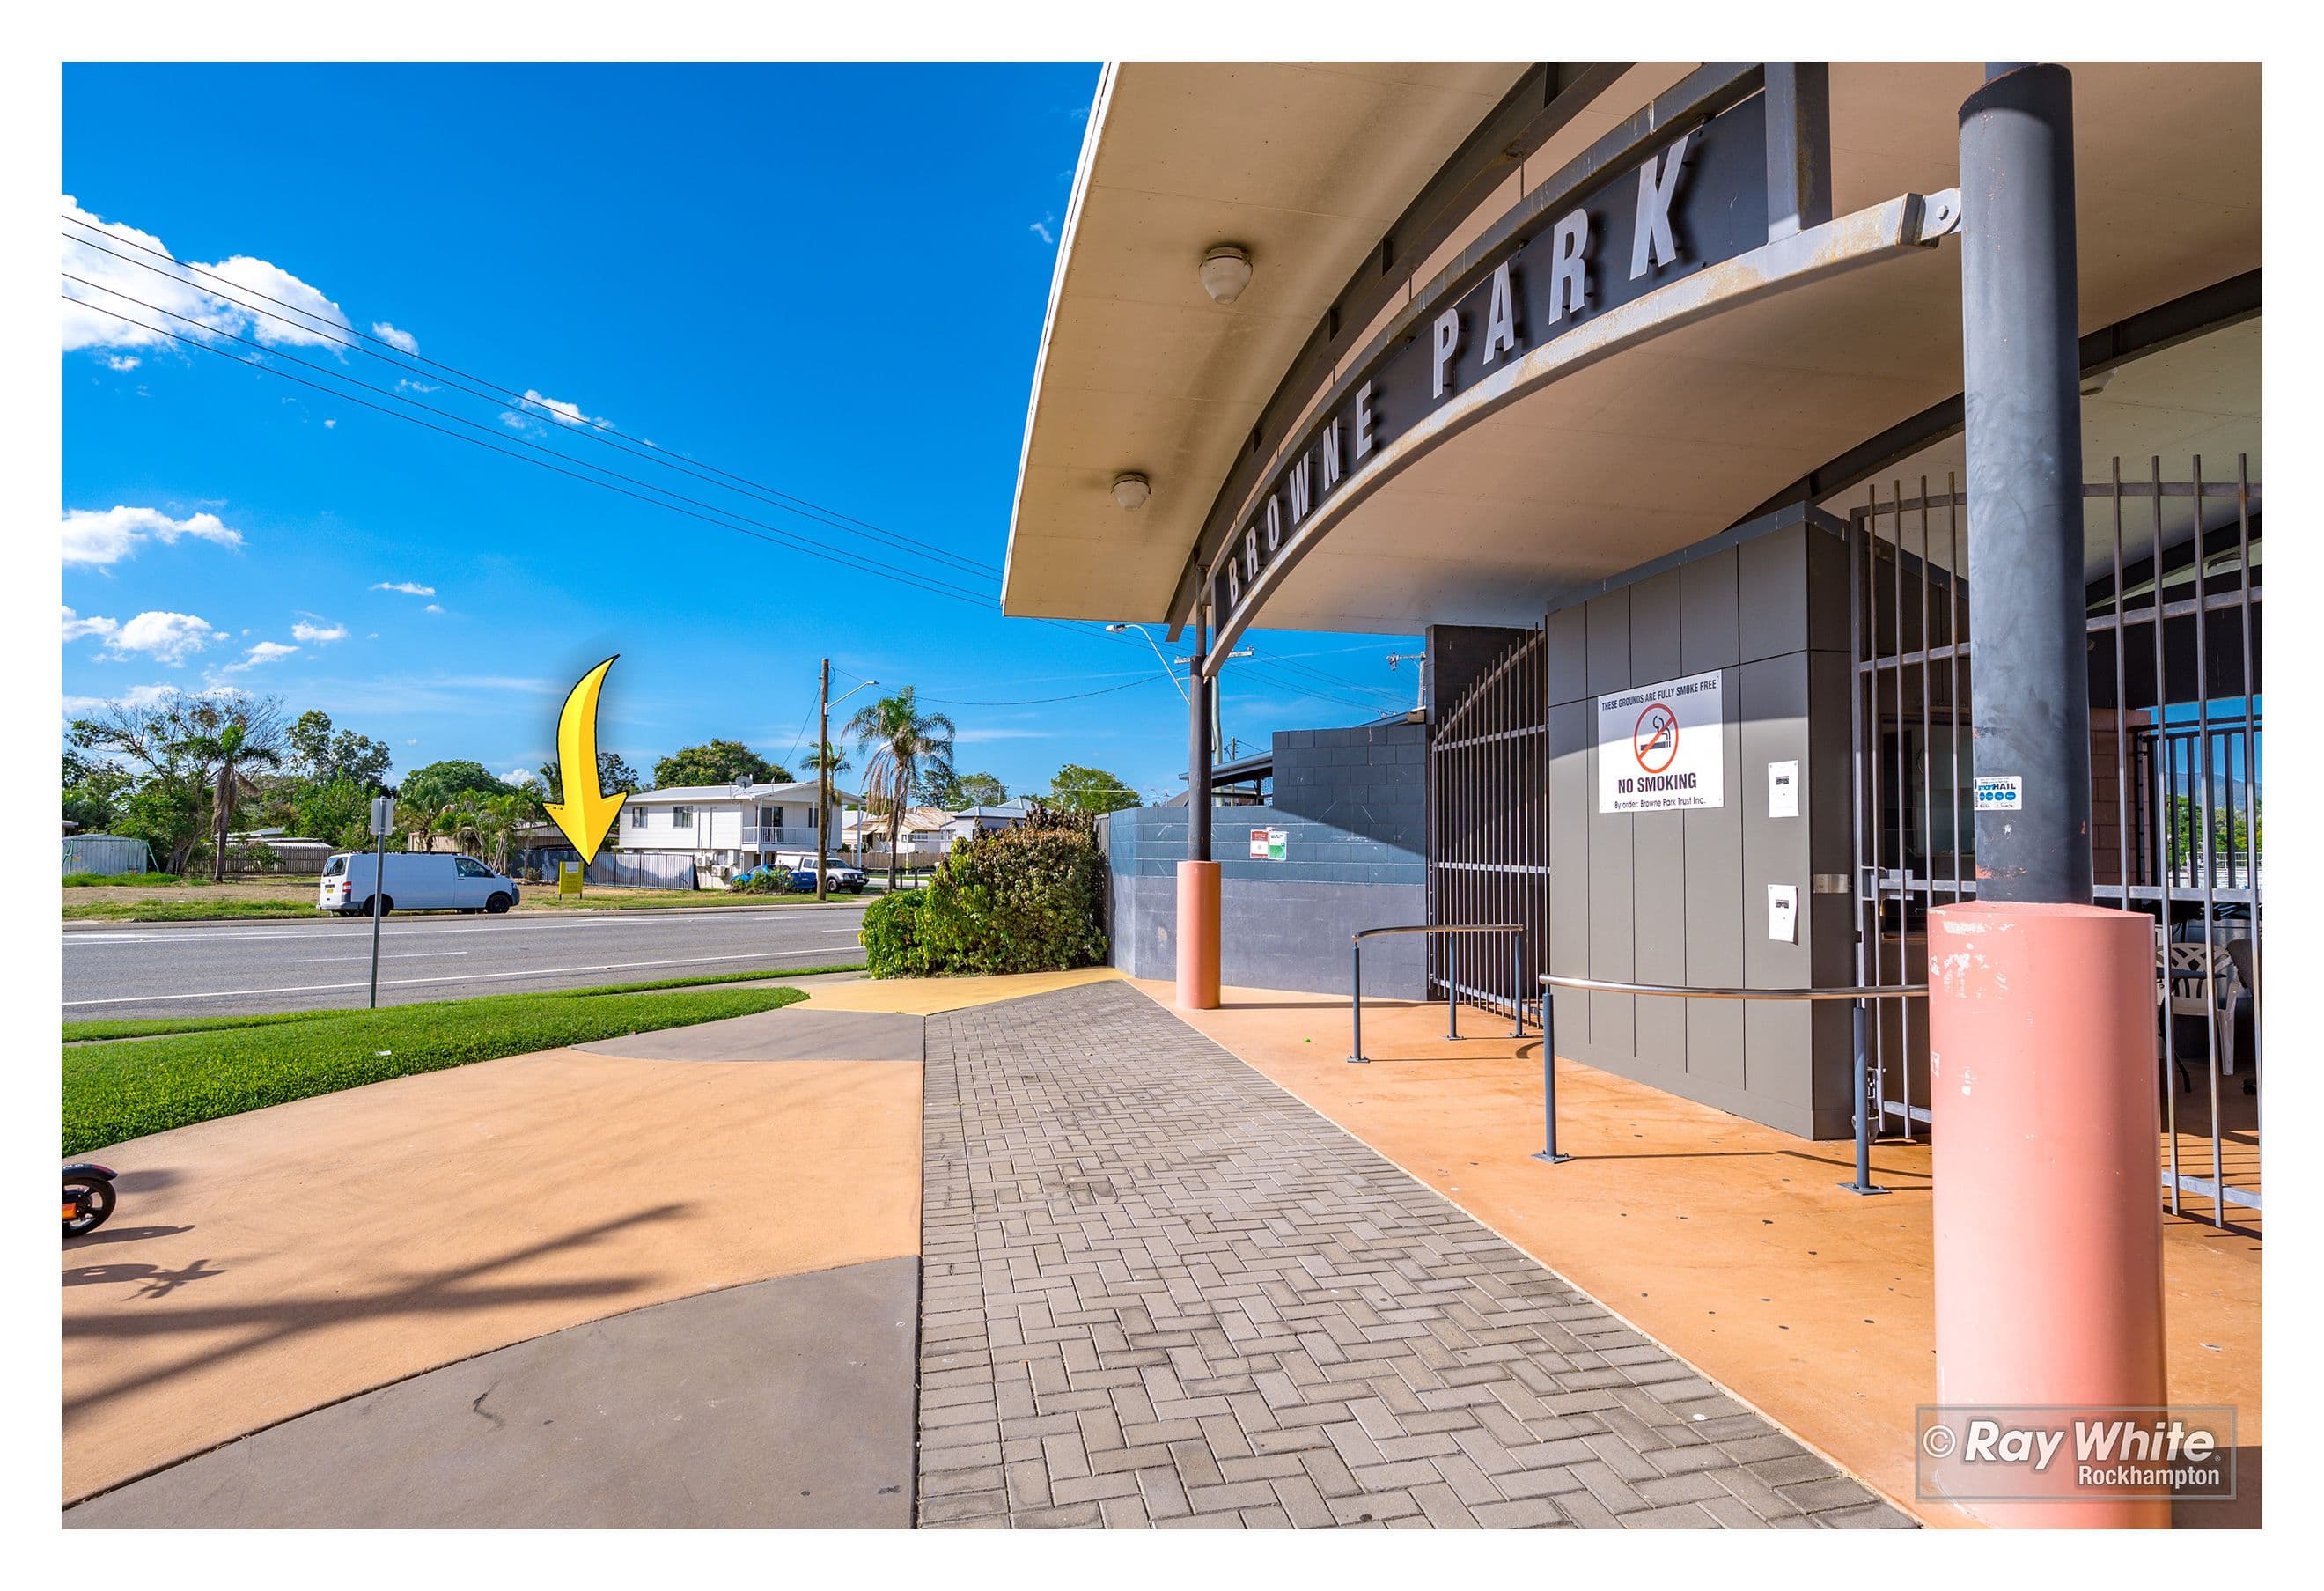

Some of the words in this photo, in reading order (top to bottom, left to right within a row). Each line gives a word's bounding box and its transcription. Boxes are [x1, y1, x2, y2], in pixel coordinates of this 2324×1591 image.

[1229, 379, 1372, 608] BROWNE
[1433, 134, 1689, 399] PARK
[1602, 700, 1617, 711] THESE
[1618, 694, 1644, 707] GROUNDS
[1644, 691, 1656, 702] ARE
[1658, 688, 1675, 700] FULLY
[1676, 682, 1698, 696] SMOKE
[1700, 679, 1717, 691] FREE
[1618, 778, 1633, 794] NO
[1637, 772, 1697, 792] SMOKING
[1614, 800, 1622, 809] By
[1640, 799, 1662, 807] Browne
[1663, 798, 1676, 807] Park
[1677, 796, 1692, 805] Trust
[1693, 796, 1706, 805] Inc.
